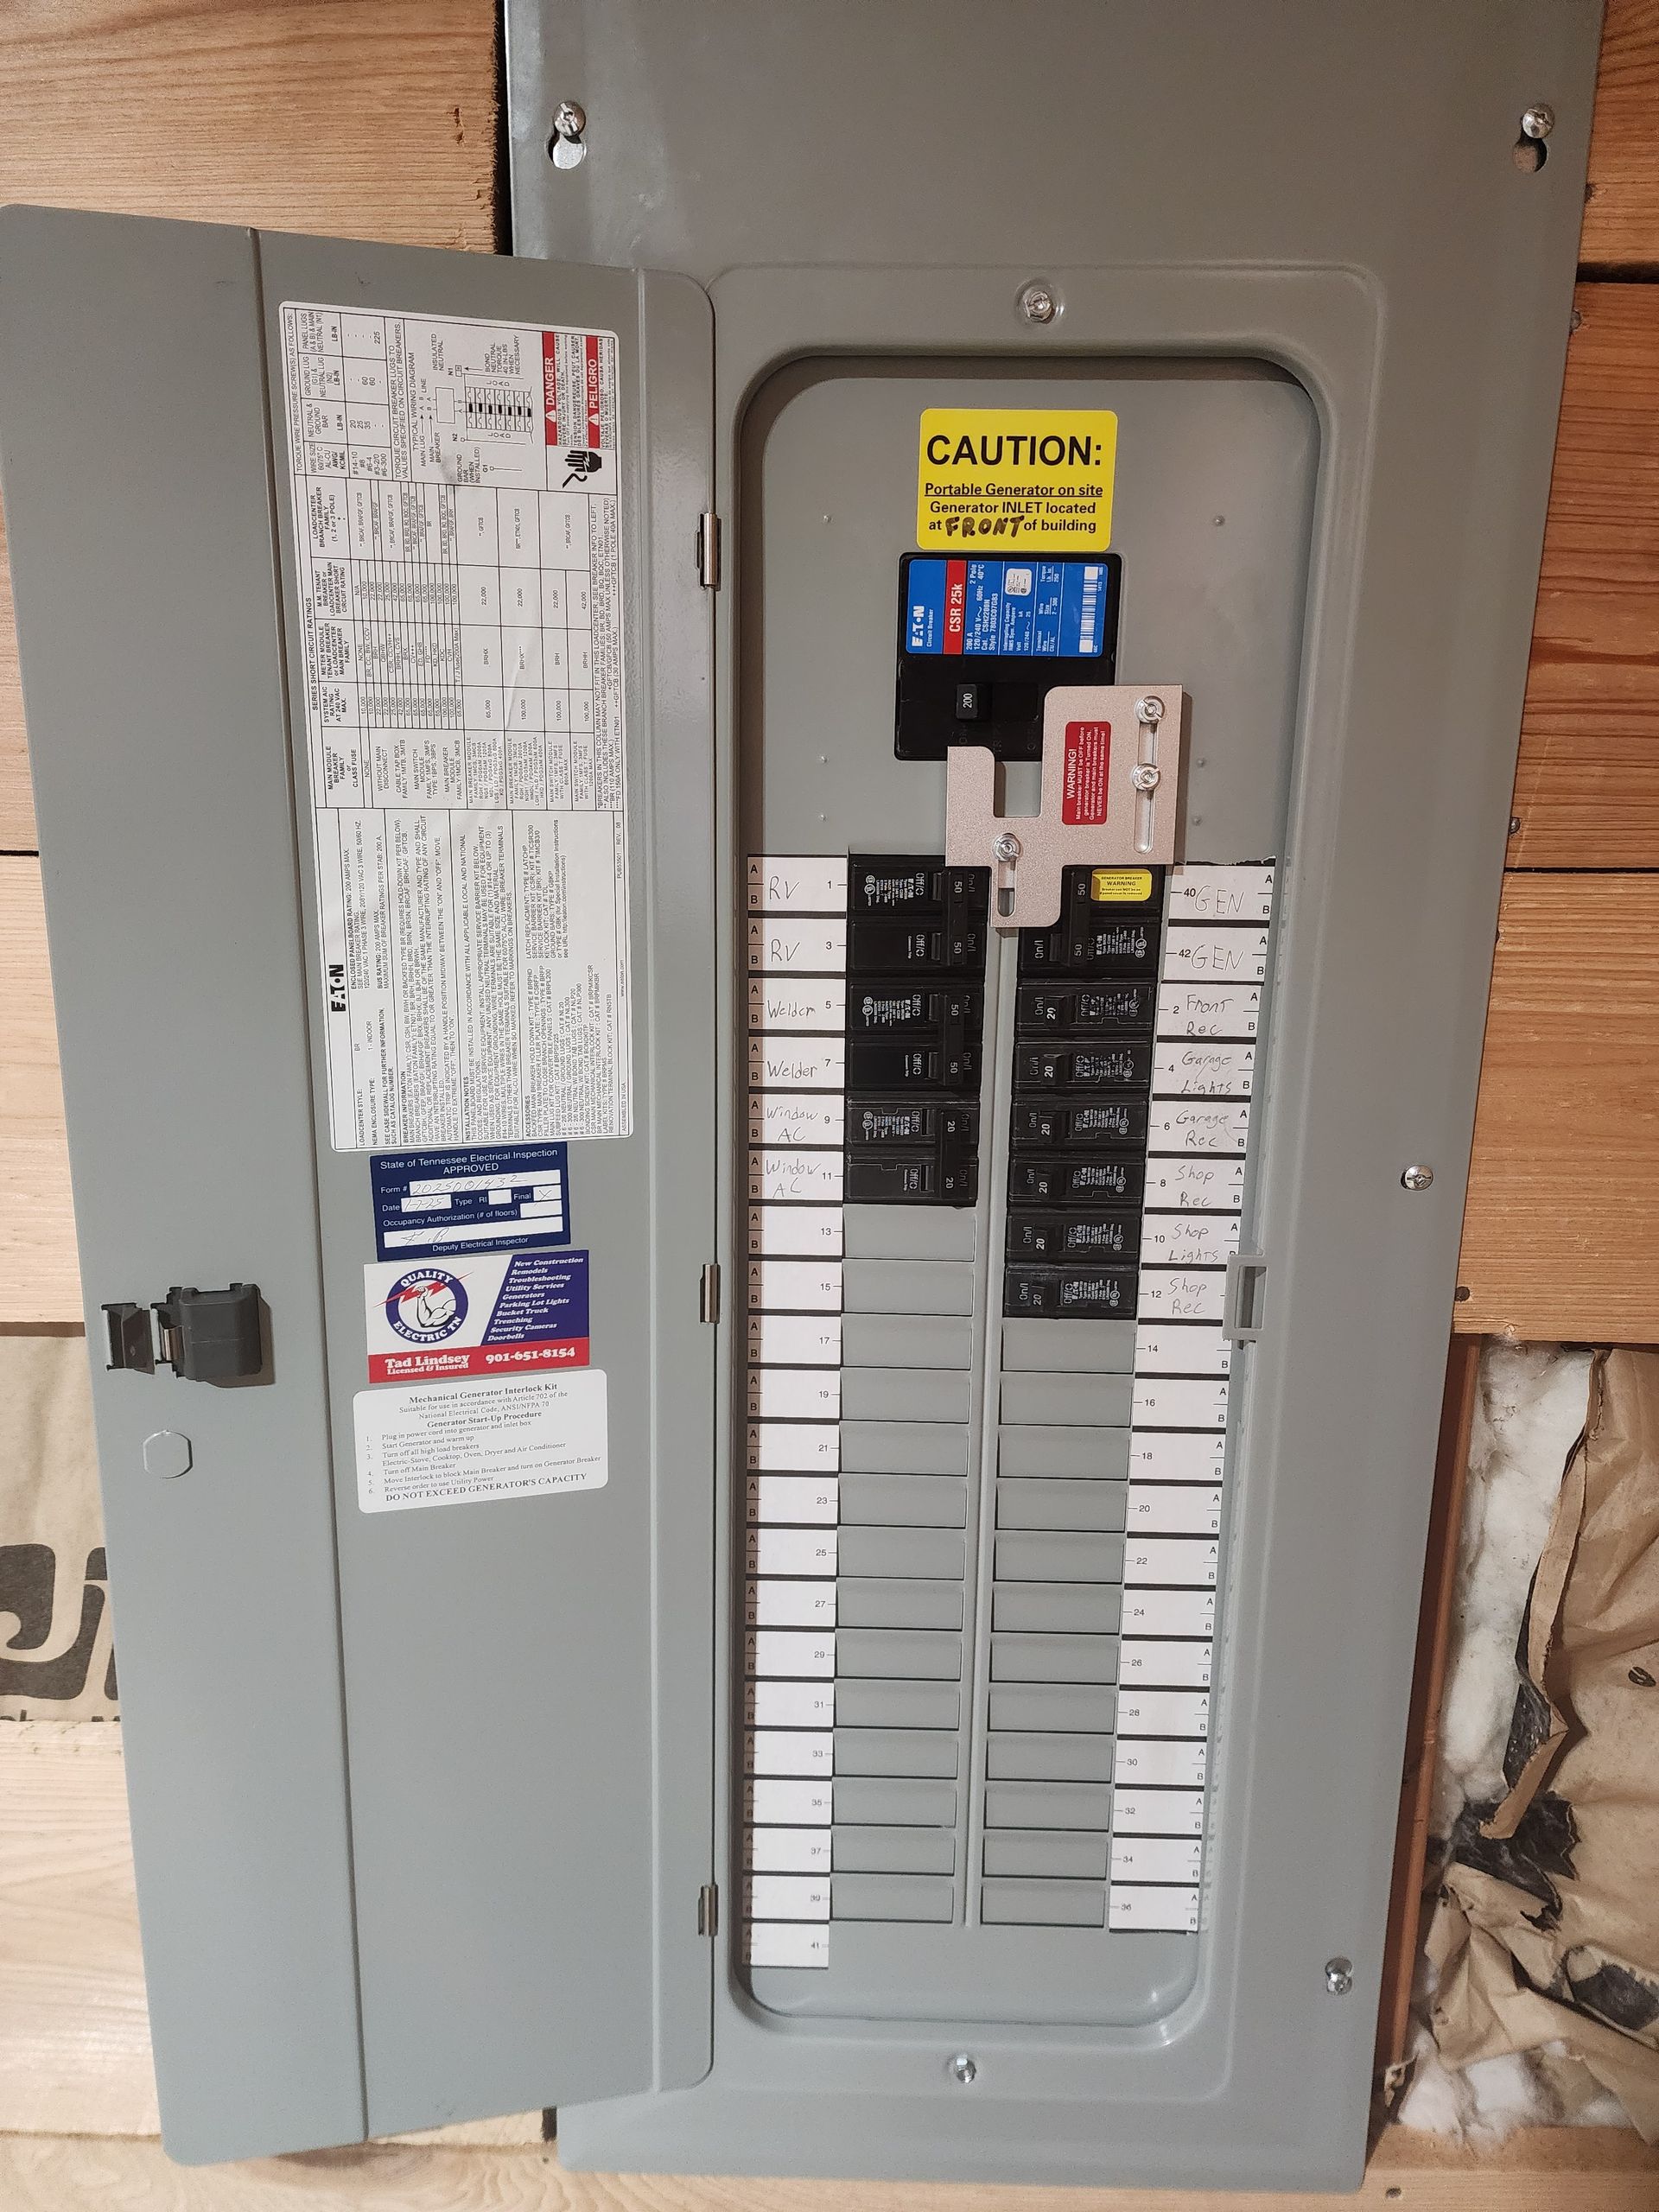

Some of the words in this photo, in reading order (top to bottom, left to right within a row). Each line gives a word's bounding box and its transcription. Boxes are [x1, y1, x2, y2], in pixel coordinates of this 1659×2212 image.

[388, 345, 395, 358] TO
[544, 357, 556, 406] DANGER
[588, 359, 598, 409] PELIGRO
[391, 416, 400, 448] CIRCUIT
[410, 420, 419, 451] TYPICAL
[927, 435, 1102, 466] CAUTION:
[925, 483, 982, 495] Portable
[986, 484, 1054, 495] Generator
[1058, 486, 1075, 495] on
[1078, 485, 1103, 496] site
[930, 501, 998, 513] Generator
[1002, 502, 1042, 513] INLET
[1046, 502, 1096, 513] located
[929, 520, 942, 531] at
[945, 516, 1024, 537] FRONT
[1024, 520, 1037, 531] of
[1041, 520, 1096, 533] building
[950, 583, 963, 604] 25k
[305, 597, 314, 631] RATINGS
[949, 608, 961, 632] CSR
[912, 606, 925, 646] EATON
[963, 693, 972, 709] 200
[1066, 748, 1077, 799] WARNING!
[770, 876, 799, 899] RV
[828, 880, 832, 889] 1
[954, 880, 963, 893] 50
[1077, 883, 1086, 896] 50
[1184, 888, 1196, 897] 40
[1195, 886, 1244, 914] GEN
[771, 939, 799, 962] RV
[954, 942, 962, 954] 50
[1179, 950, 1191, 958] 42
[1192, 944, 1244, 971] GEN
[328, 964, 346, 1012] EATON
[1186, 994, 1234, 1014] Front
[1187, 1021, 1223, 1035] Rec
[950, 1062, 958, 1073] 50
[1182, 1051, 1231, 1071] Garage
[767, 1060, 817, 1079] Welder
[1045, 1065, 1053, 1077] 20
[1181, 1079, 1231, 1095] Lights
[766, 1106, 818, 1120] Window
[1176, 1109, 1229, 1128] Garage
[778, 1127, 805, 1142] AC
[948, 1121, 956, 1133] 20
[1185, 1131, 1217, 1147] Rec
[380, 1160, 405, 1169] State
[418, 1155, 467, 1166] Tennessee
[470, 1151, 511, 1162] Electrical
[513, 1148, 557, 1161] Inspection
[443, 1163, 499, 1174] APPROVED
[766, 1159, 822, 1175] Window
[946, 1177, 954, 1189] 20
[1175, 1166, 1214, 1187] Shop
[773, 1178, 801, 1198] AC
[454, 1198, 473, 1206] Type
[1180, 1192, 1212, 1207] Rec
[384, 1217, 425, 1228] Occupancy
[427, 1211, 474, 1223] Authorization
[1172, 1224, 1209, 1240] Shop
[433, 1243, 459, 1252] Deputy
[461, 1239, 493, 1249] Electrical
[495, 1236, 528, 1247] Inspector
[534, 1256, 583, 1265] Construction
[1169, 1250, 1218, 1264] Lights
[400, 1270, 454, 1287] QUALITY
[509, 1274, 571, 1284] Troubleshooting
[1168, 1278, 1207, 1297] Shop
[1173, 1299, 1206, 1314] Rec
[392, 1322, 448, 1343] ELECTRIC
[446, 1316, 462, 1332] TN
[385, 1358, 412, 1368] Tad
[415, 1354, 470, 1366] Lindsey
[486, 1347, 575, 1363] 901-651-8154
[387, 1366, 424, 1375] Licensed
[435, 1362, 469, 1370] Insured
[409, 1392, 458, 1403] Mechanical
[460, 1388, 503, 1400] Generator
[505, 1384, 543, 1395] Interlock
[544, 1382, 558, 1391] Kit
[427, 1418, 467, 1428] Generator
[468, 1414, 501, 1424] Start-Up
[504, 1410, 542, 1421] Procedure
[385, 1493, 401, 1502] DO
[403, 1490, 423, 1500] NOT
[426, 1486, 467, 1497] EXCEED
[468, 1478, 536, 1493] GENERATOR'S
[537, 1473, 587, 1486] CAPACITY
